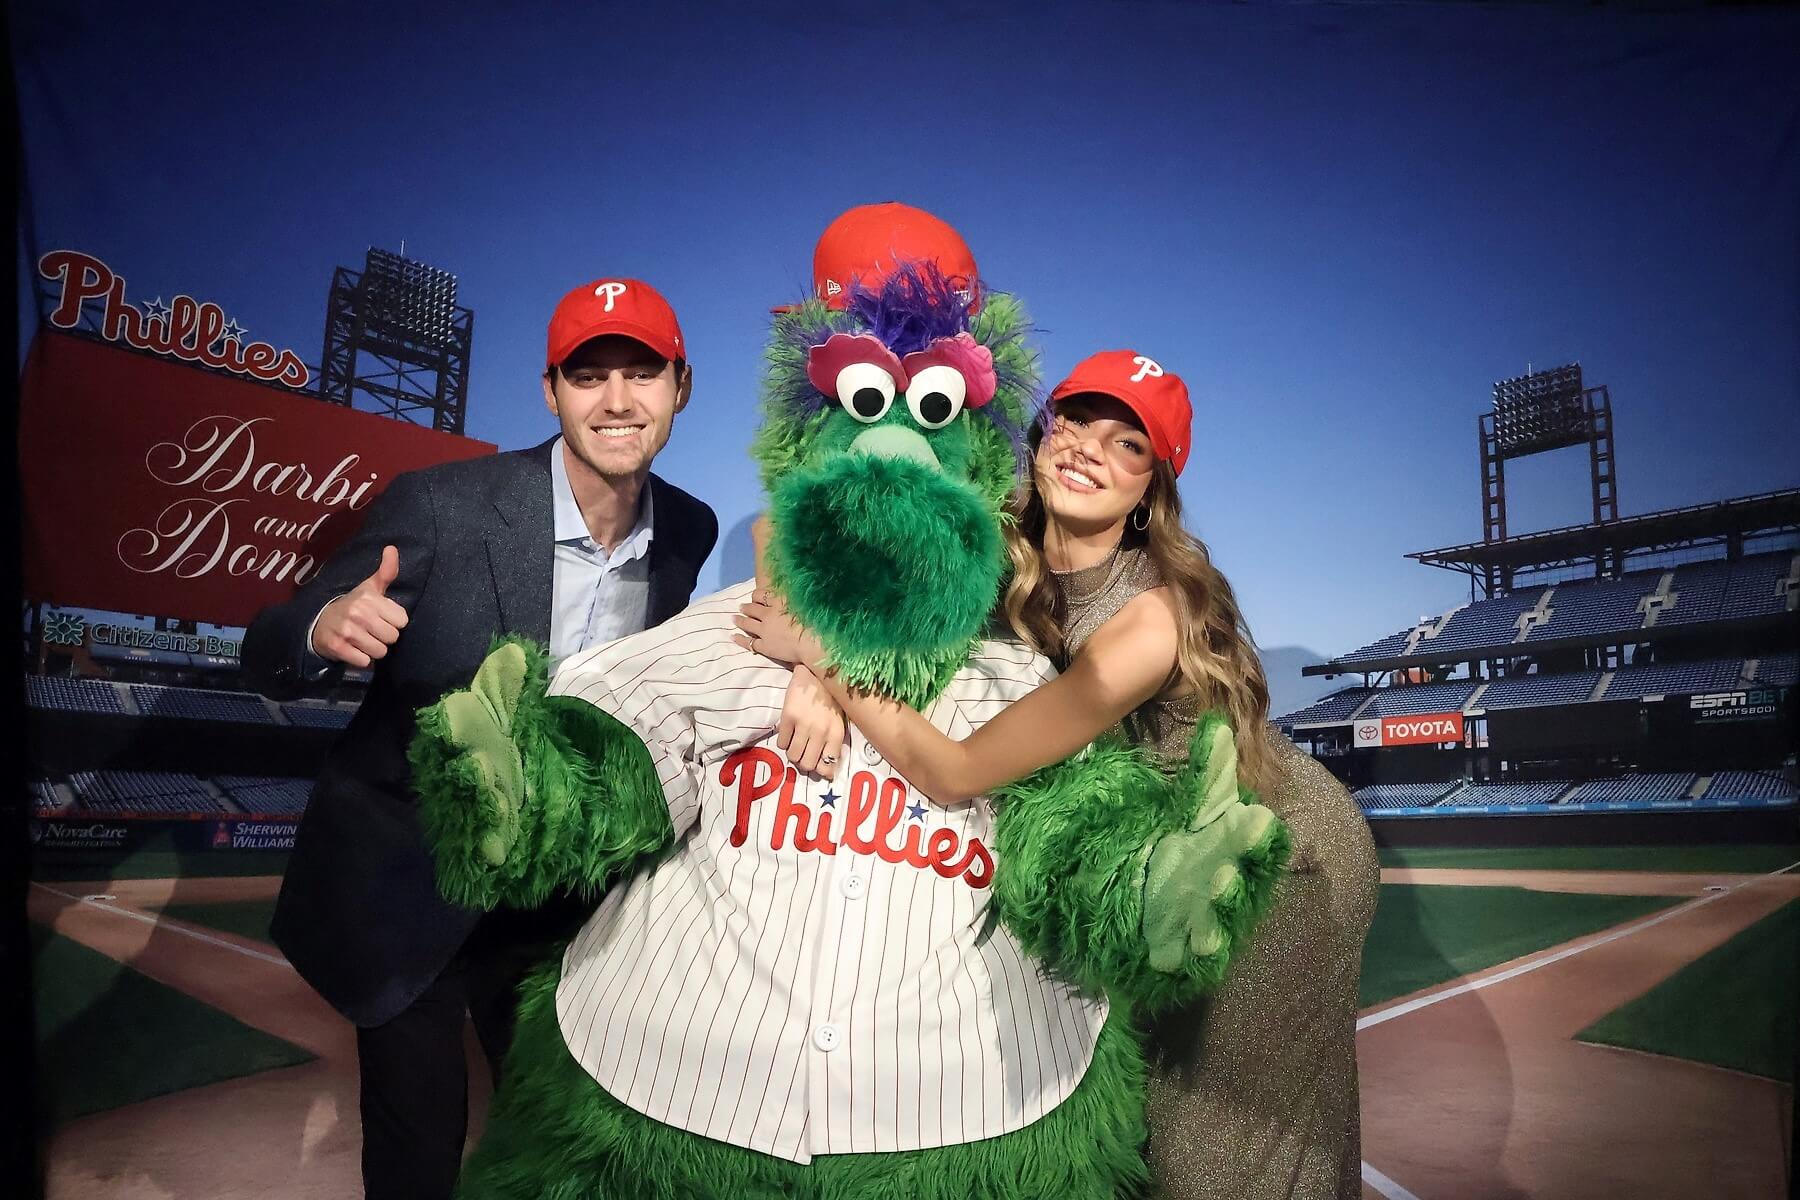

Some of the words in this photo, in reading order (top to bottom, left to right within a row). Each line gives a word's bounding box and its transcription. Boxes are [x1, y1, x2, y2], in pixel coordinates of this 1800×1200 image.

[594, 281, 628, 313] P
[39, 250, 309, 387] Phillies
[1129, 355, 1165, 383] P
[146, 415, 377, 510] Darbi
[254, 514, 331, 541] and
[118, 499, 327, 585] Dom
[90, 622, 200, 653] Citizens
[1690, 691, 1747, 709] ESPN
[1386, 720, 1457, 738] TOYOTA
[44, 823, 128, 839] NovaCare
[234, 822, 298, 835] SHERWIN
[719, 746, 995, 889] Phillies
[232, 835, 297, 848] WILLIAMS
